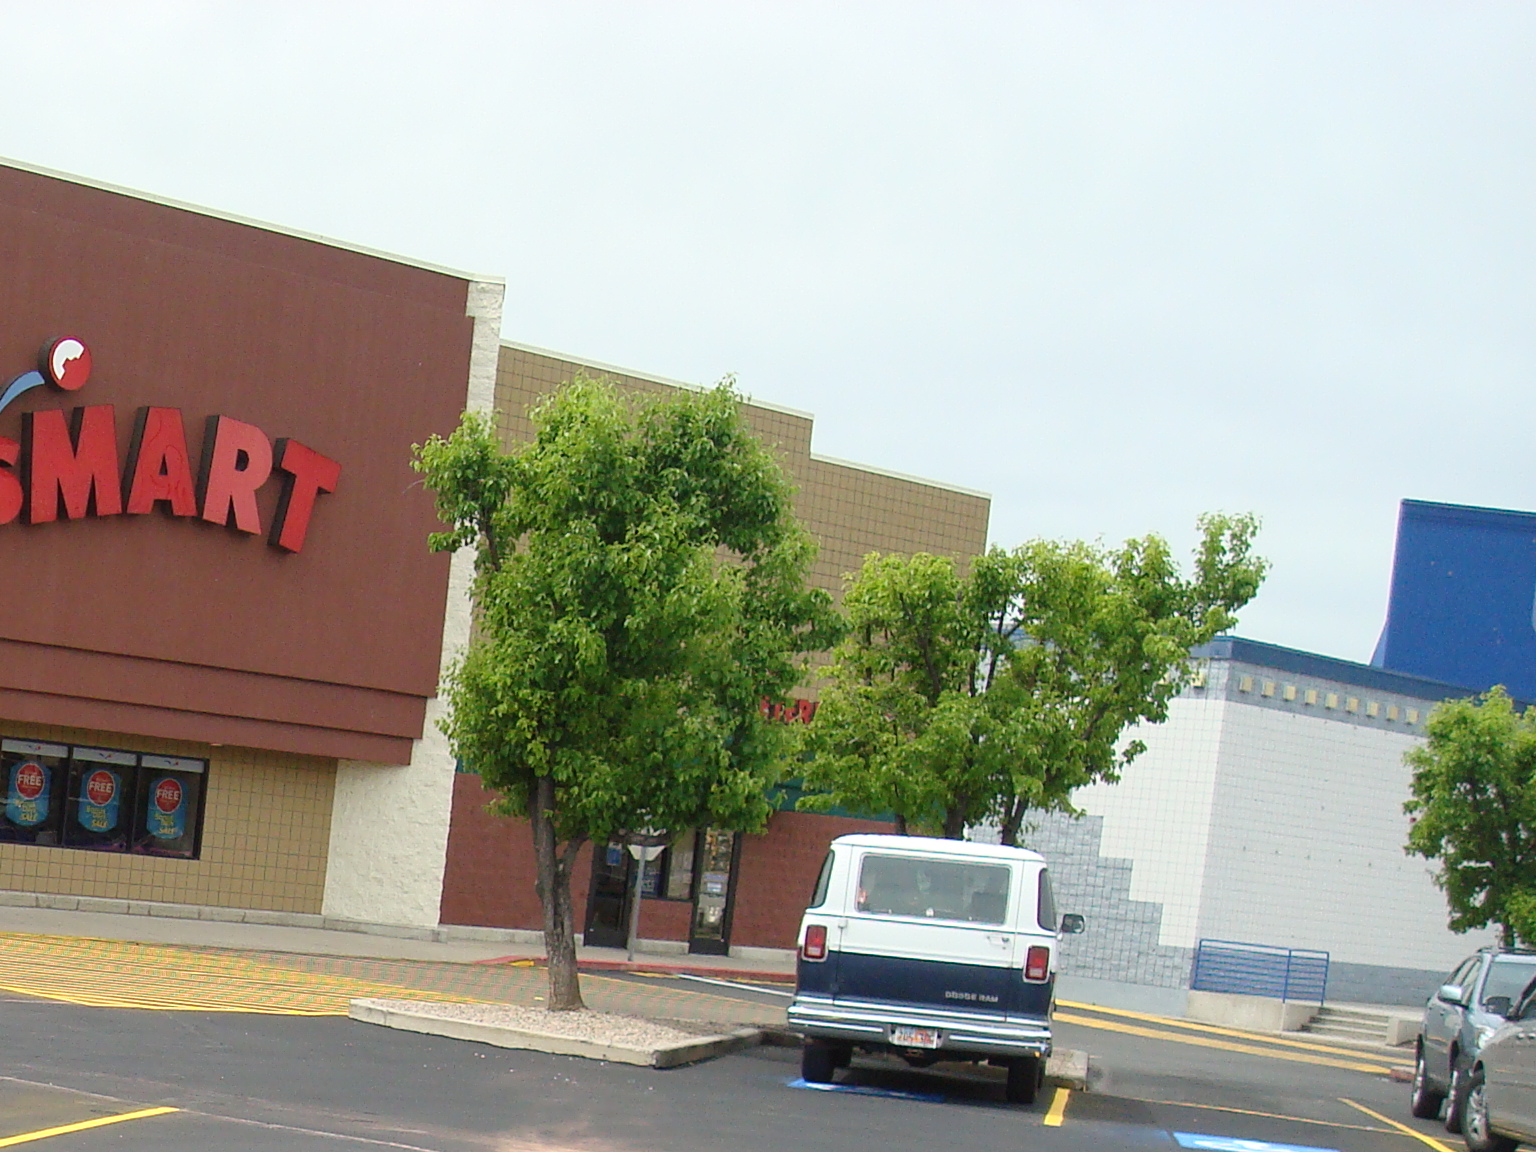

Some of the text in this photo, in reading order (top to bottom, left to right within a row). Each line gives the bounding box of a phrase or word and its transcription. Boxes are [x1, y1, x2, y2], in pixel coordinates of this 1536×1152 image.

[17, 774, 42, 786] FREE
[88, 781, 113, 793] FREE
[156, 789, 180, 800] FREE
[945, 991, 998, 1003] DODGE RAM
